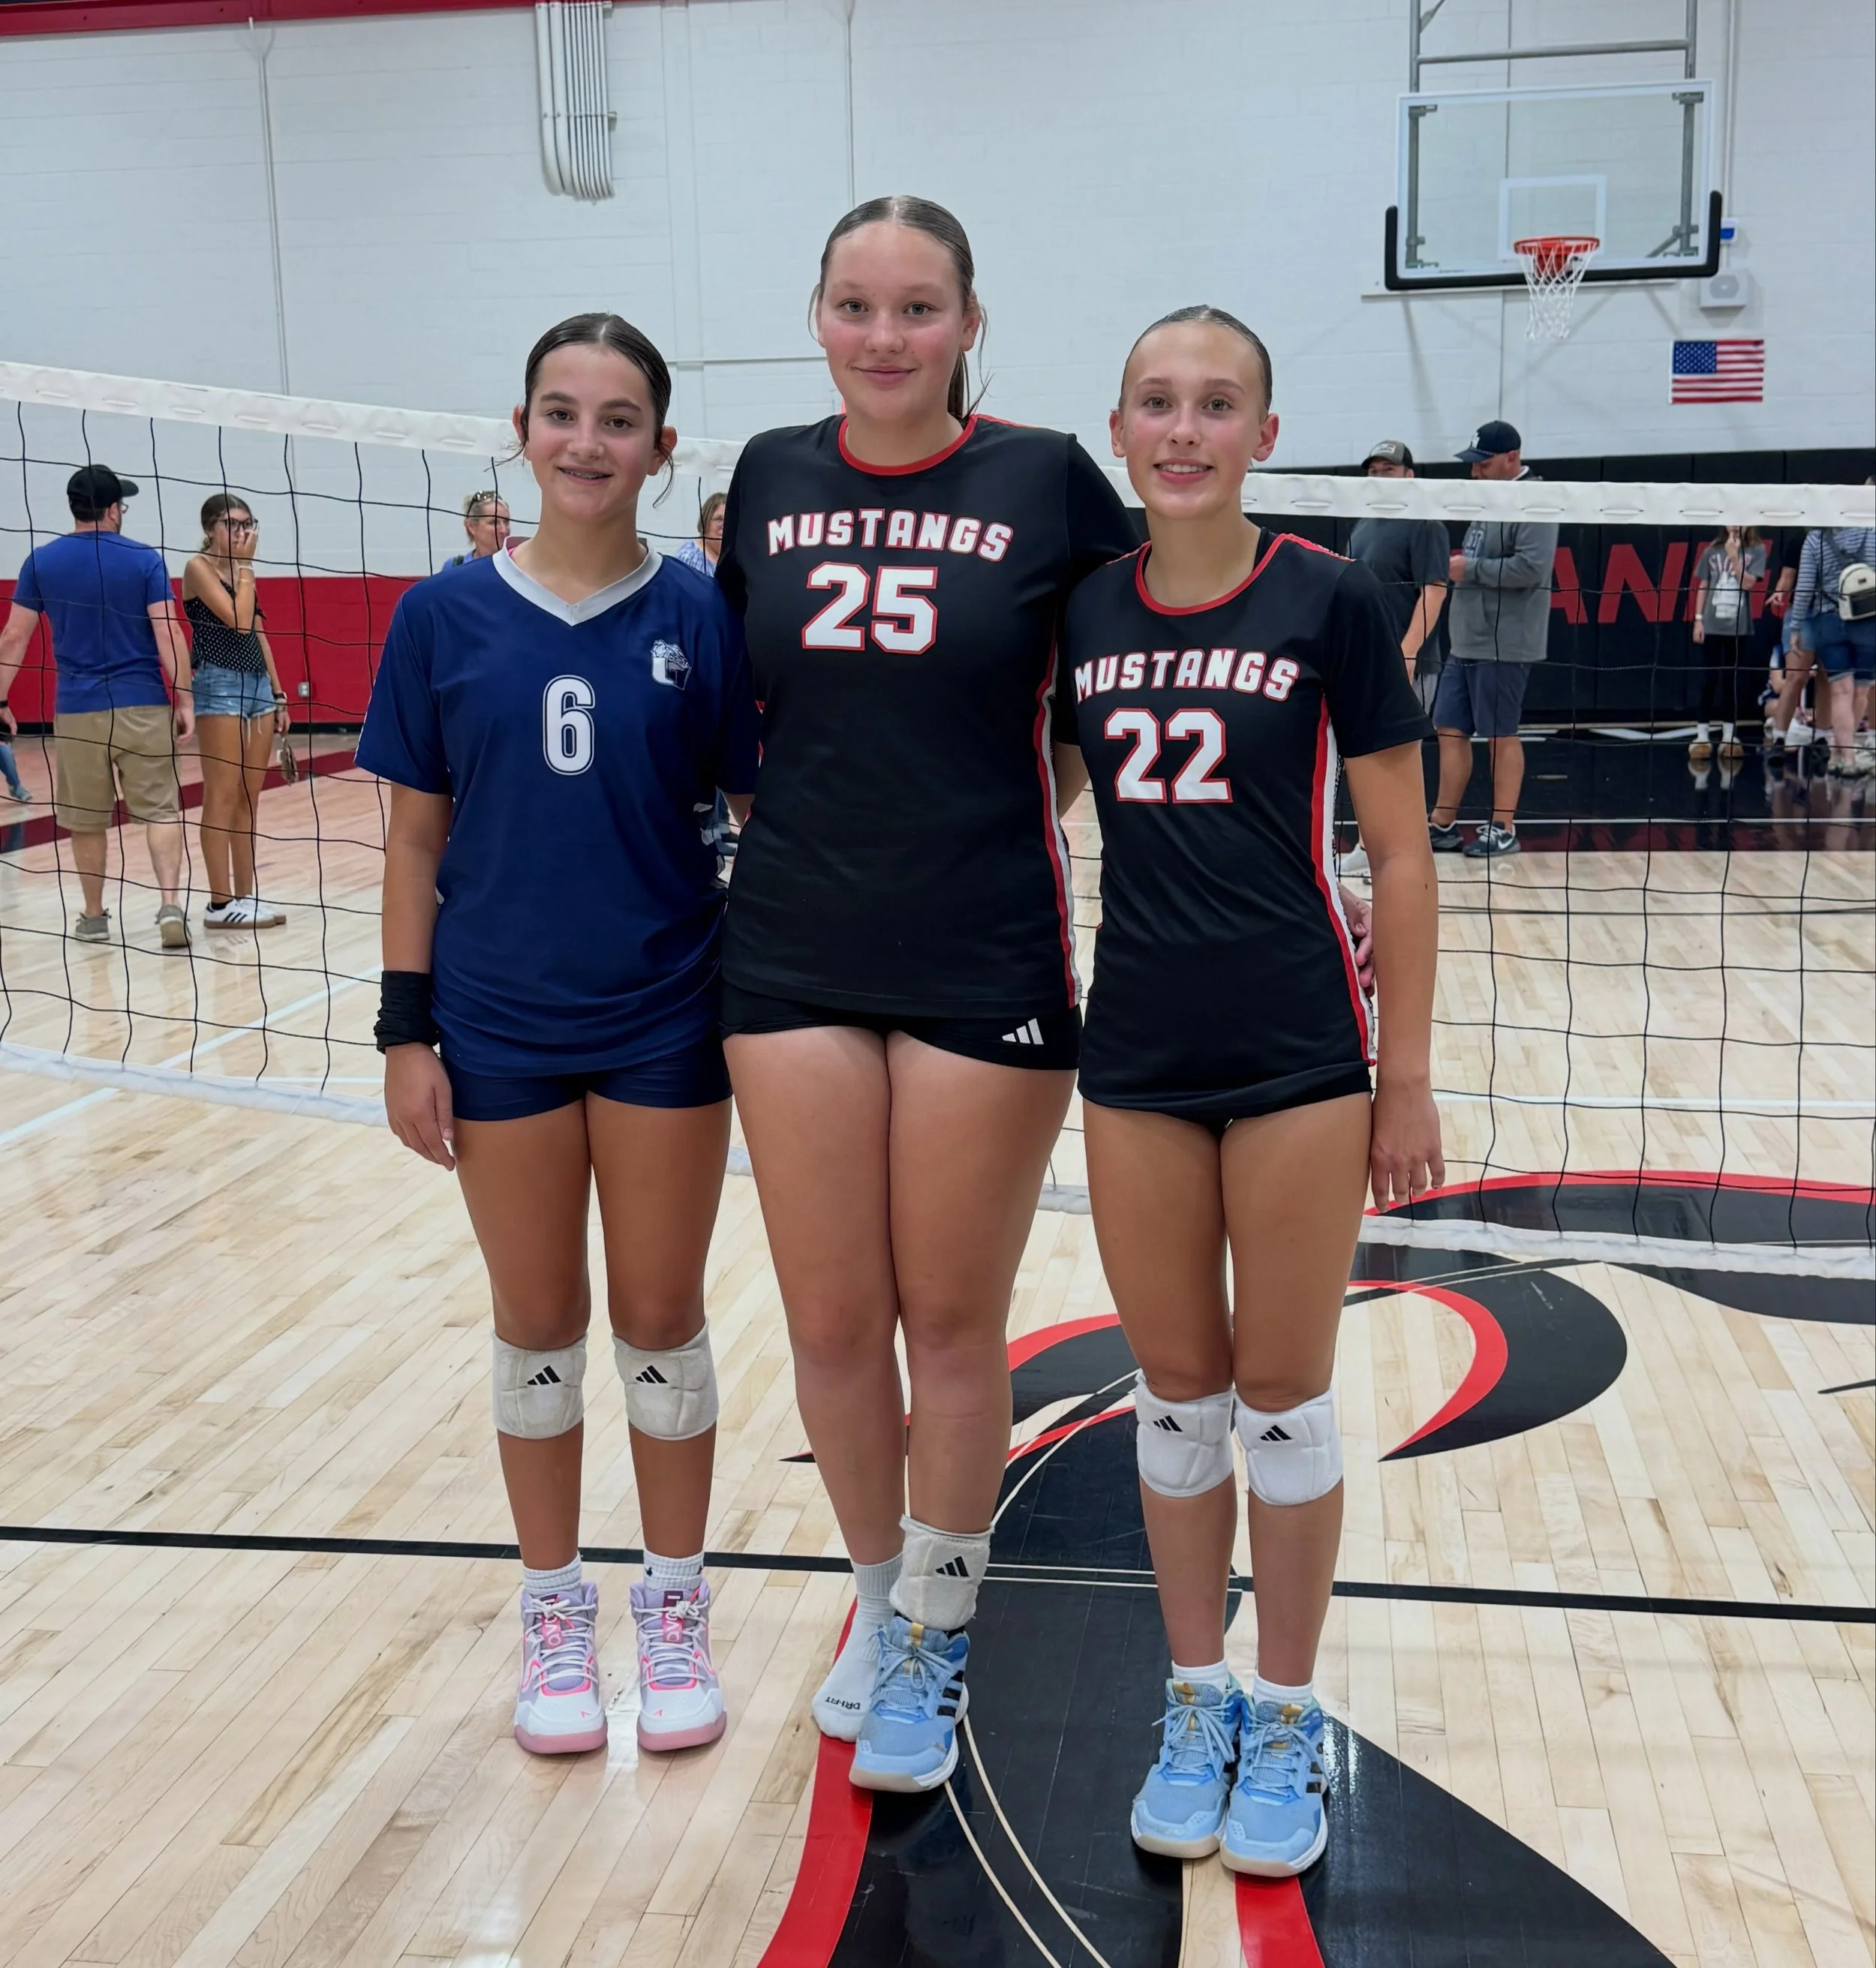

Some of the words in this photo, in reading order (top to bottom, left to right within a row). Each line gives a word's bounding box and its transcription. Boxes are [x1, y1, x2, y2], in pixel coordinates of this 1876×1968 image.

[768, 509, 1013, 562] MUSTANGS
[802, 562, 938, 654] 25
[1075, 648, 1300, 704] MUSTANGS
[543, 675, 596, 776] 6
[1105, 708, 1234, 804] 22
[825, 1696, 861, 1710] DRI-FIT
